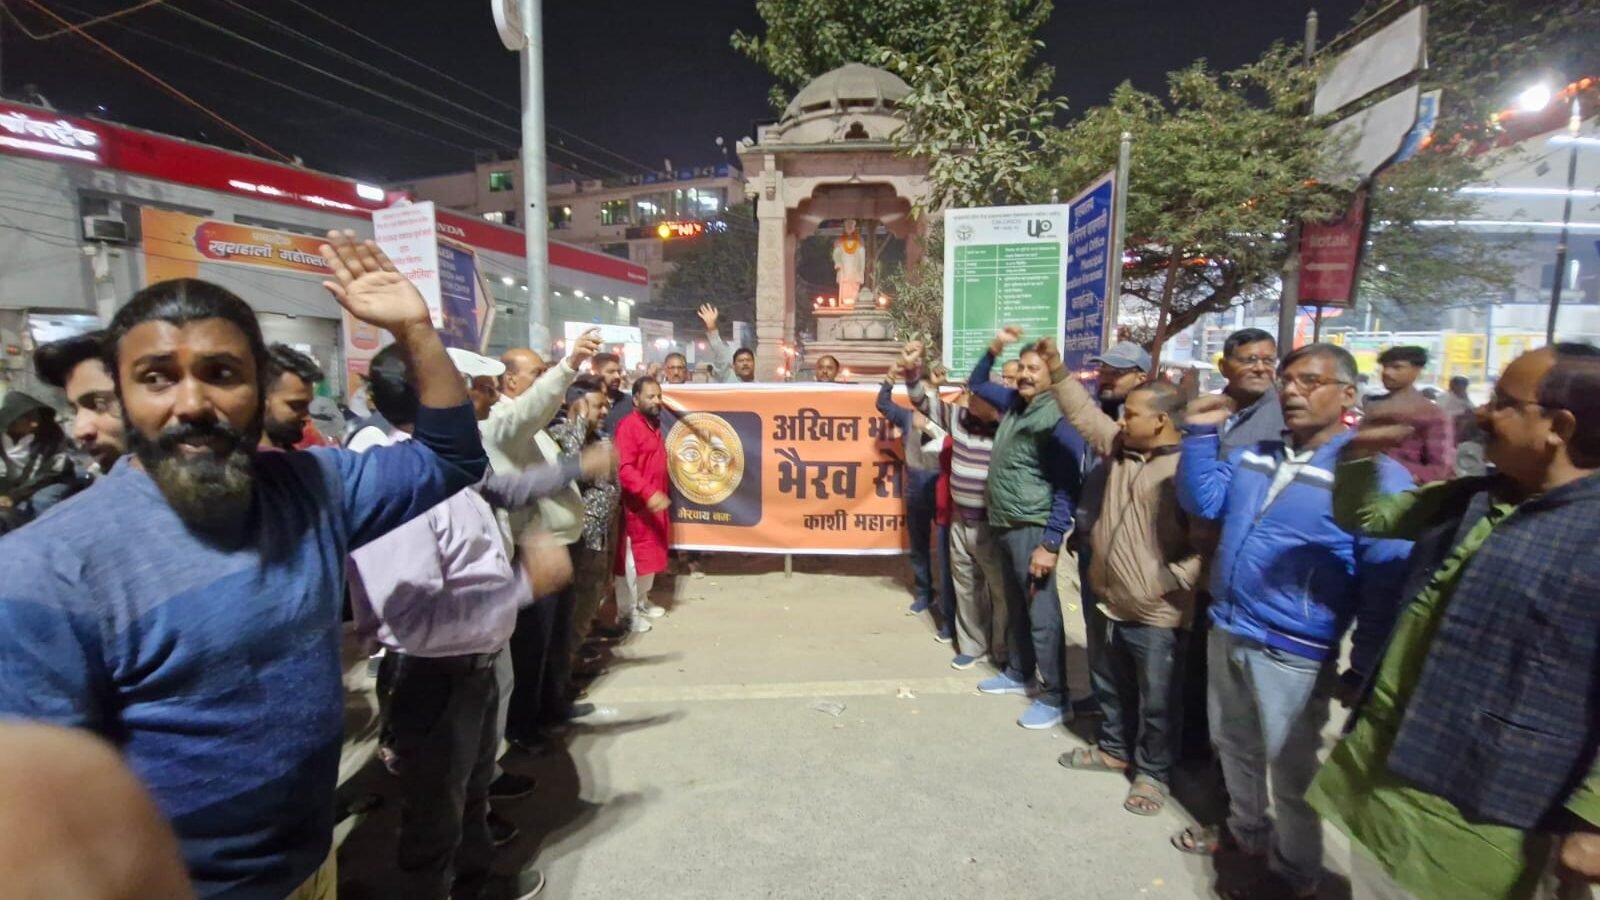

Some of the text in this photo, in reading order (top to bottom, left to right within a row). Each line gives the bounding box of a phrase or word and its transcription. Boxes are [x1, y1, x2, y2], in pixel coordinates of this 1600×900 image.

[436, 222, 466, 238] NDA
[773, 407, 896, 441] अखिल भा
[774, 447, 904, 499] भैरव से
[803, 509, 848, 531] काशी
